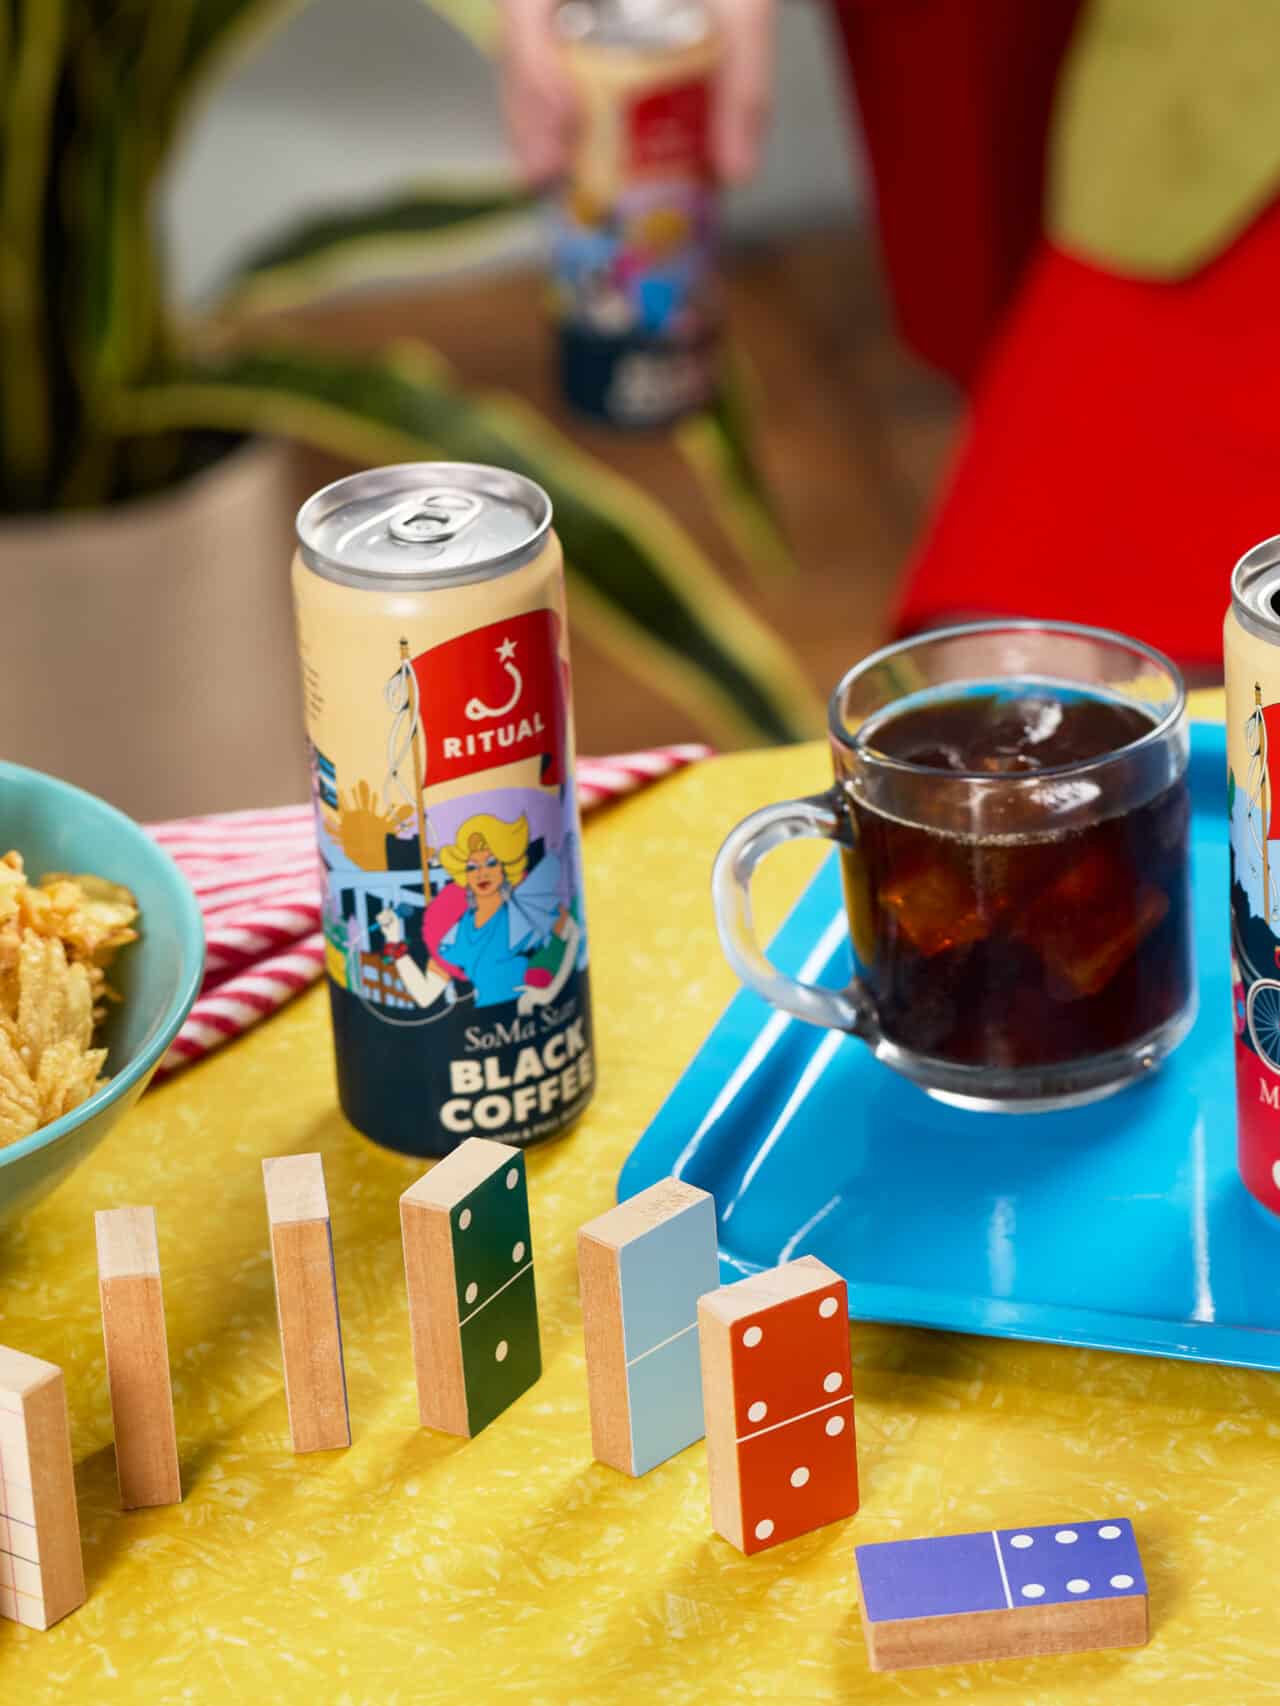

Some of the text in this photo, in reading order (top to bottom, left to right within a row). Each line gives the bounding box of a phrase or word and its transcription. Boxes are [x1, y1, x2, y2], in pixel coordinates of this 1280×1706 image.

[442, 711, 545, 759] RITUAL
[449, 1017, 585, 1095] BLACK
[463, 1018, 536, 1052] SoMa
[439, 1051, 593, 1133] COFFEE
